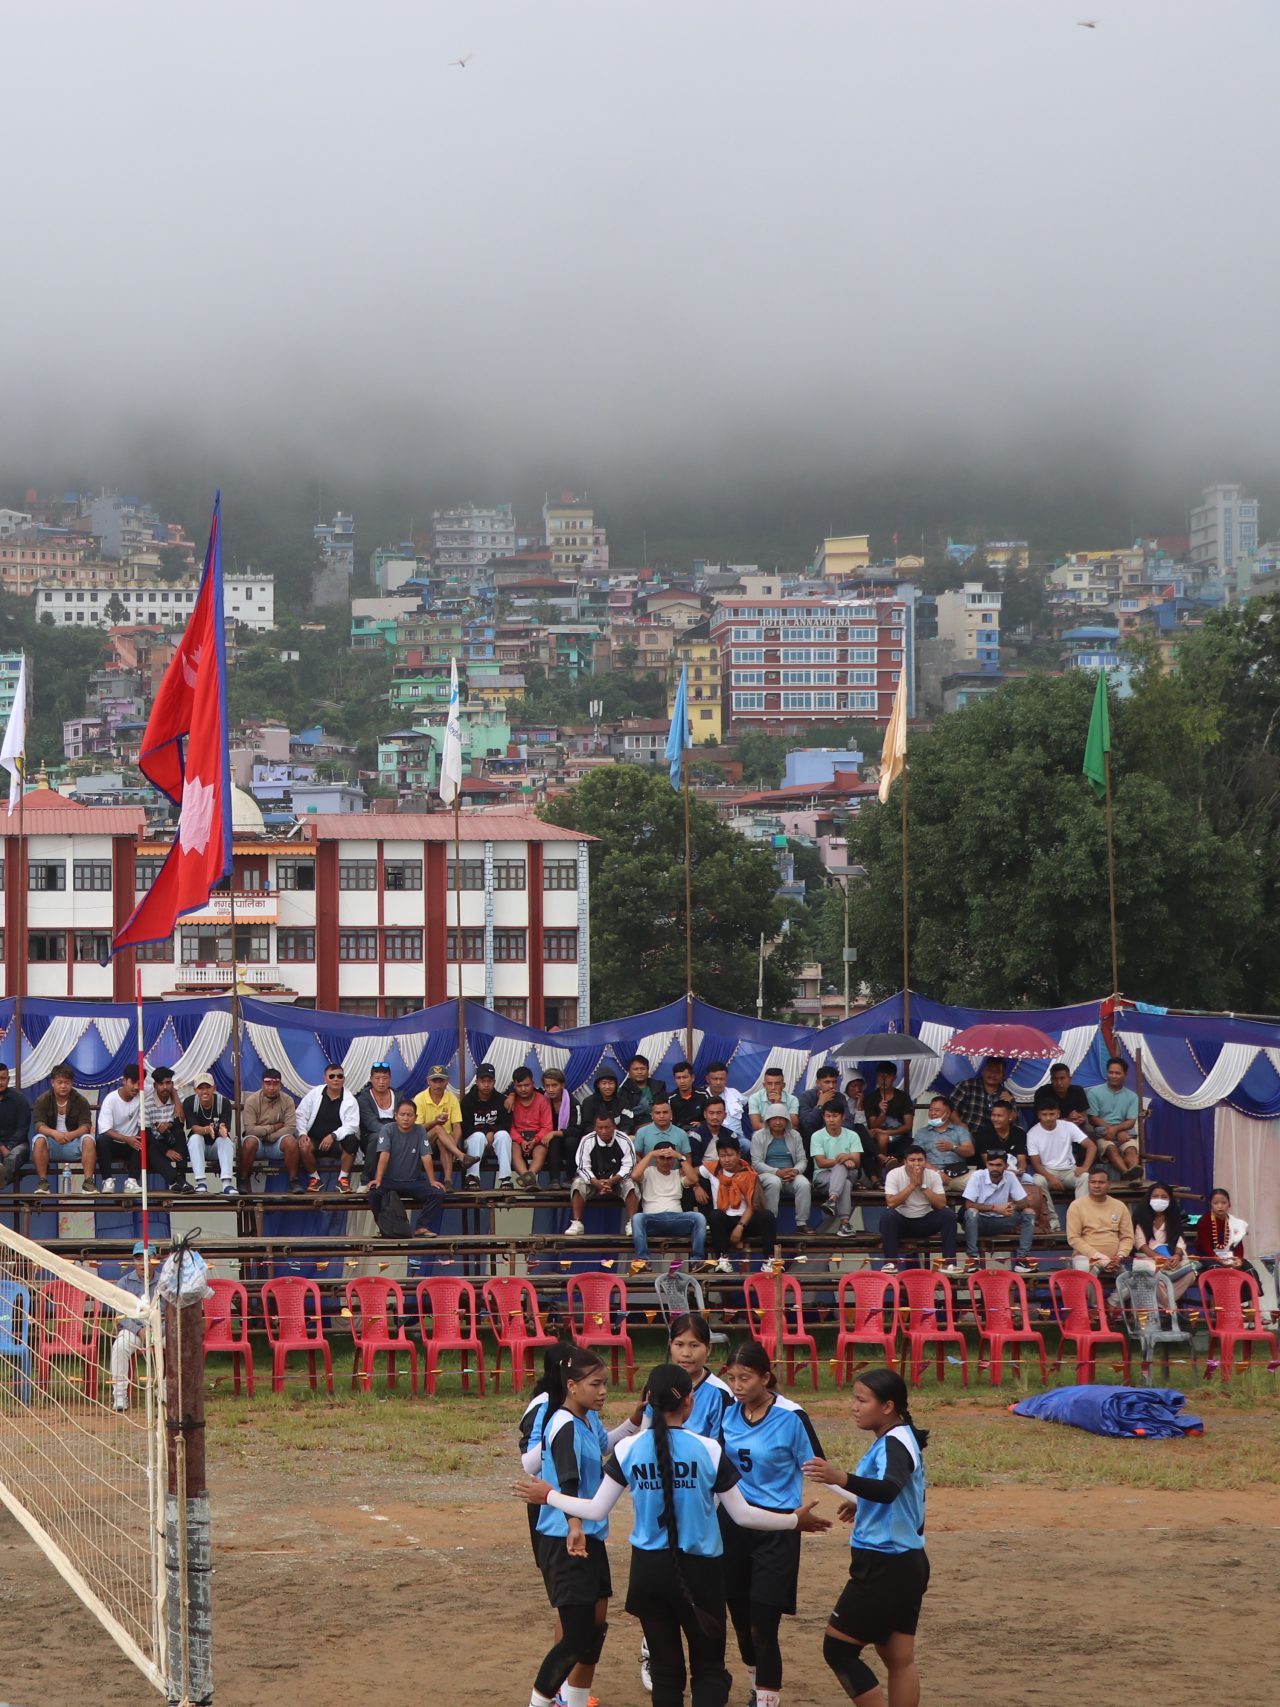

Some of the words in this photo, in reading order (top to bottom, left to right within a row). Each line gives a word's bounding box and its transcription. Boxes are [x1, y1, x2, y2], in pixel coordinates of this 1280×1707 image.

[760, 618, 790, 627] HOTEL
[793, 618, 851, 627] ANNAPURNA
[737, 1448, 753, 1473] 5
